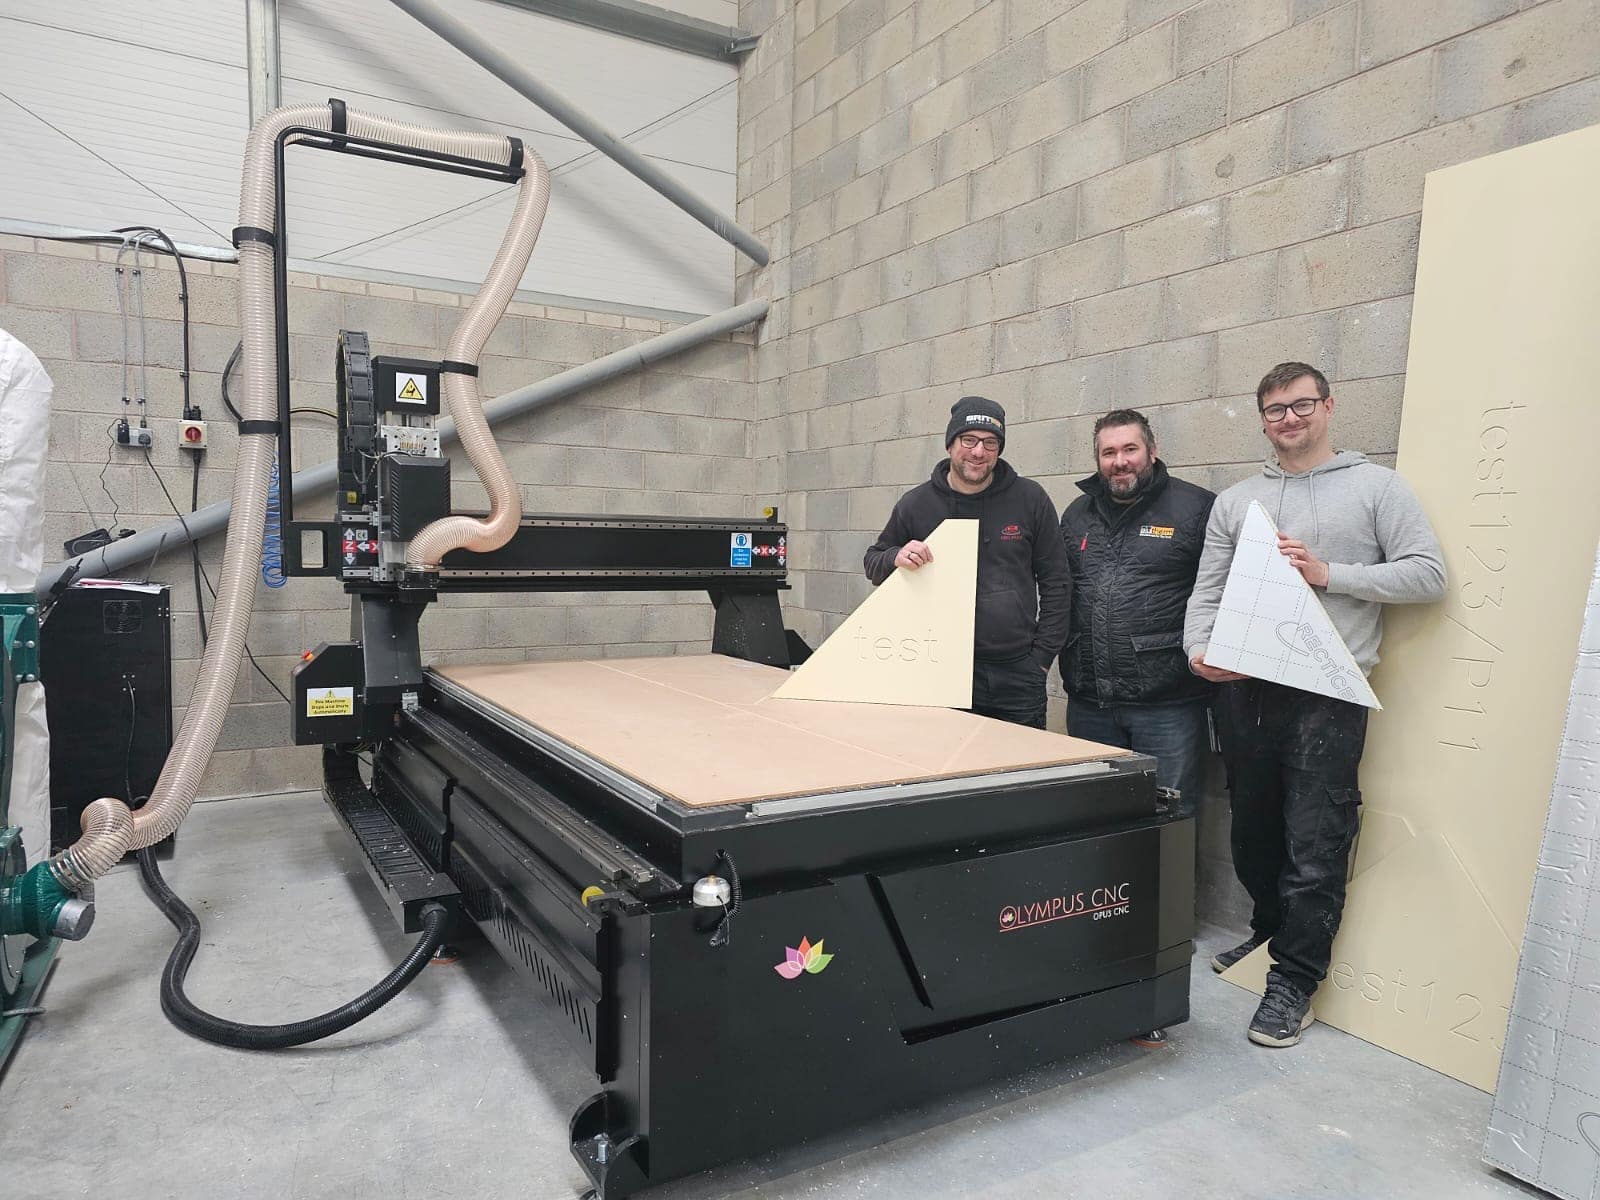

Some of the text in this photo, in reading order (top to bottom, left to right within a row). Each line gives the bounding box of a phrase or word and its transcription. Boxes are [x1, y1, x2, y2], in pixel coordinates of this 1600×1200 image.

[853, 625, 939, 663] test
[1000, 883, 1130, 929] OLYMPUS CNC
[1113, 905, 1130, 916] CNC
